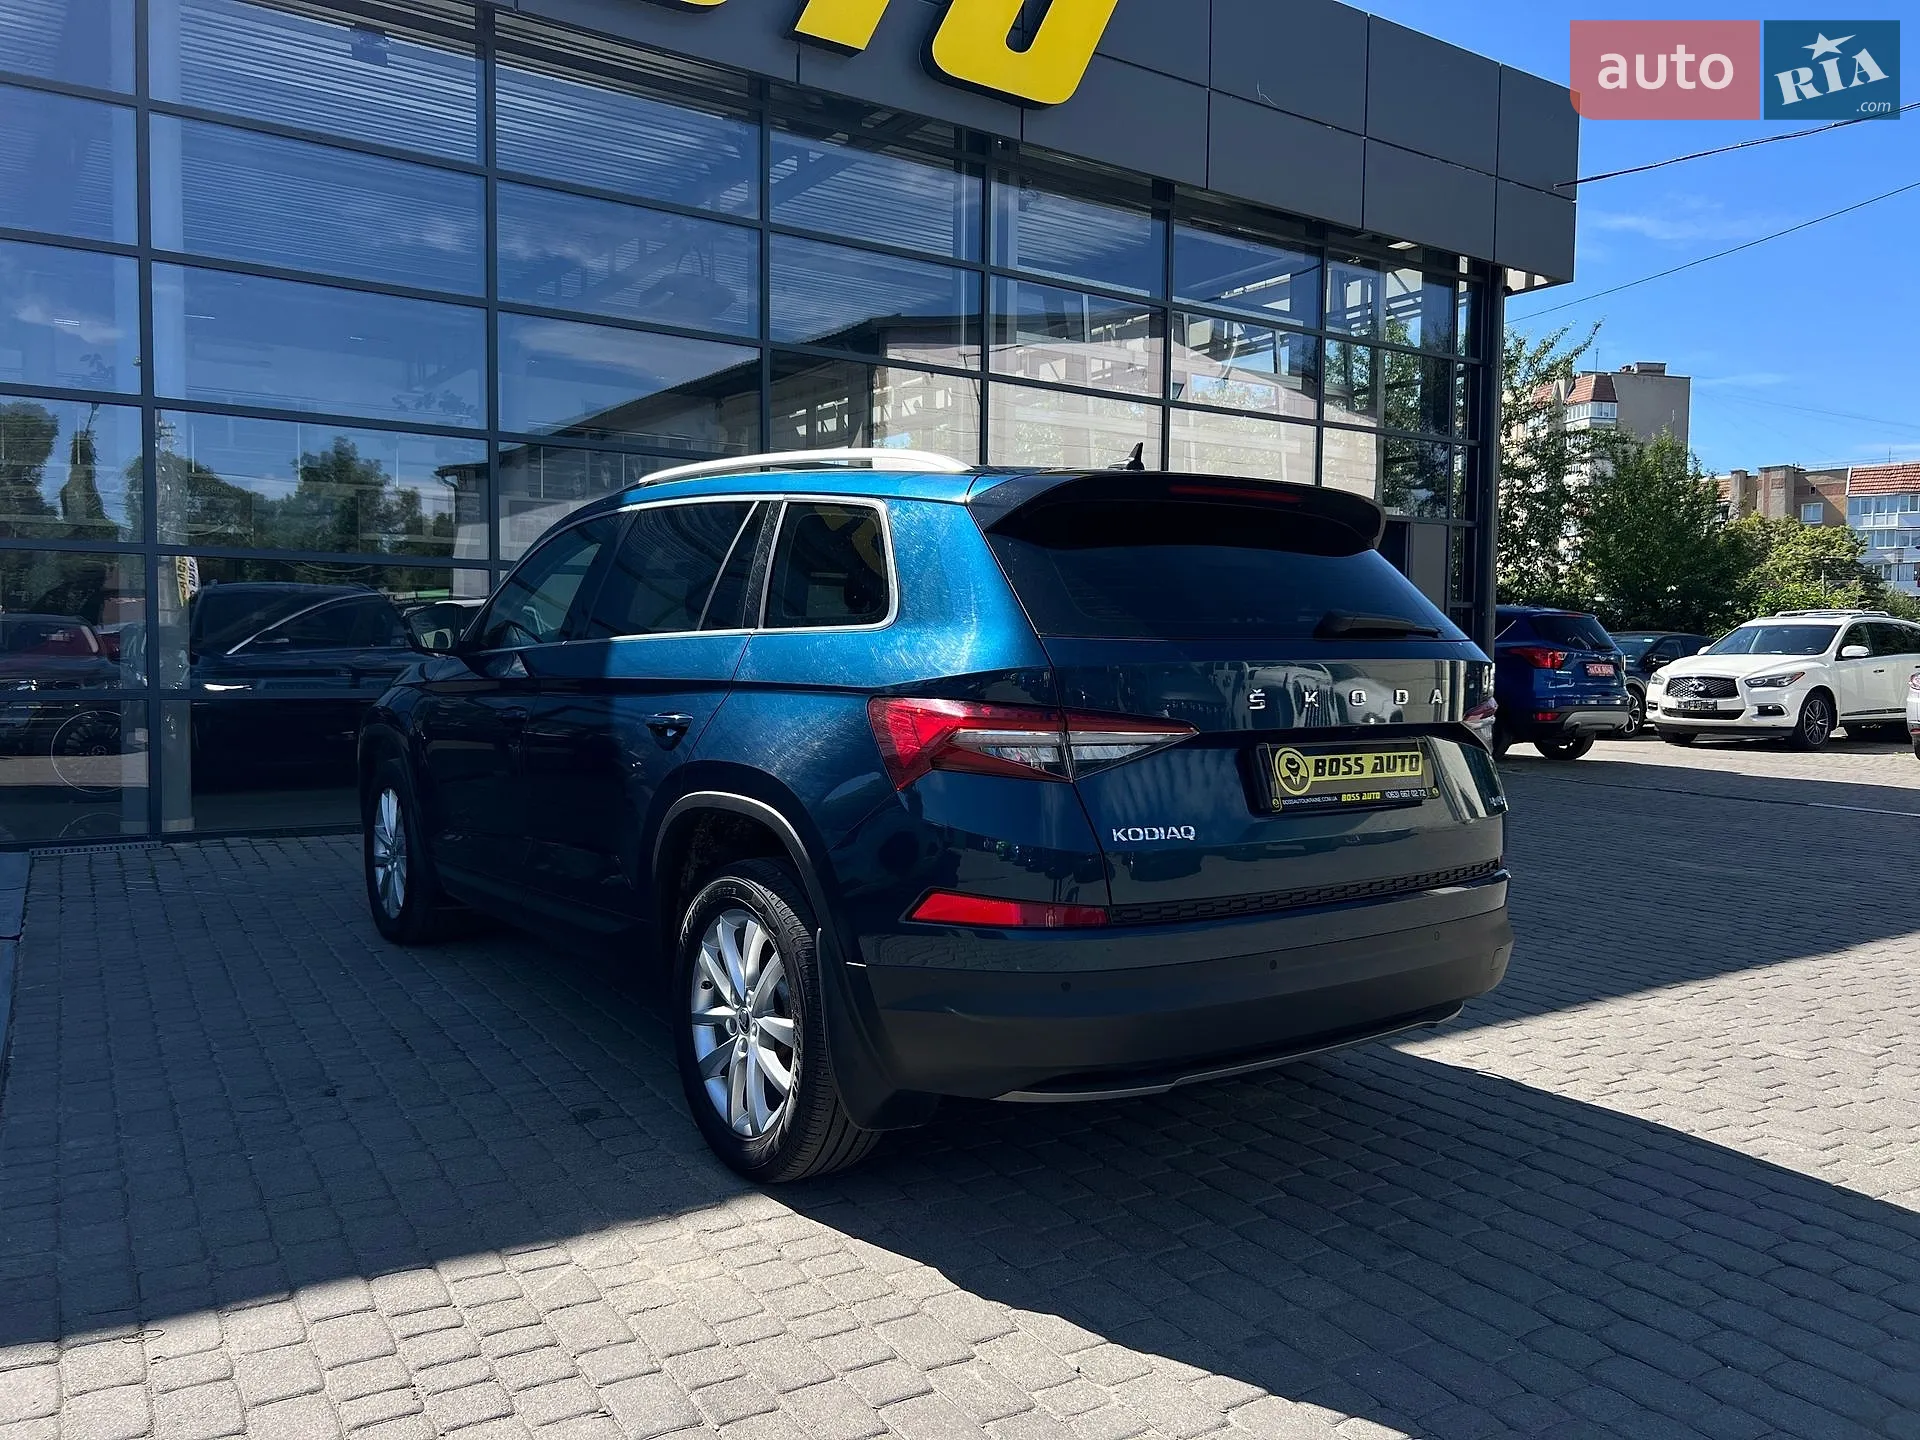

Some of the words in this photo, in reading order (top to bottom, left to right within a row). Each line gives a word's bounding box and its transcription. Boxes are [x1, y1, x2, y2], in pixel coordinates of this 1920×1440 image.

[1249, 688, 1445, 710] ŠKODA
[1313, 756, 1364, 777] BOSS
[1371, 754, 1420, 774] AUTO
[1341, 793, 1360, 802] BOSS
[1362, 791, 1381, 800] AUTO
[1112, 825, 1196, 841] KODIAQ
